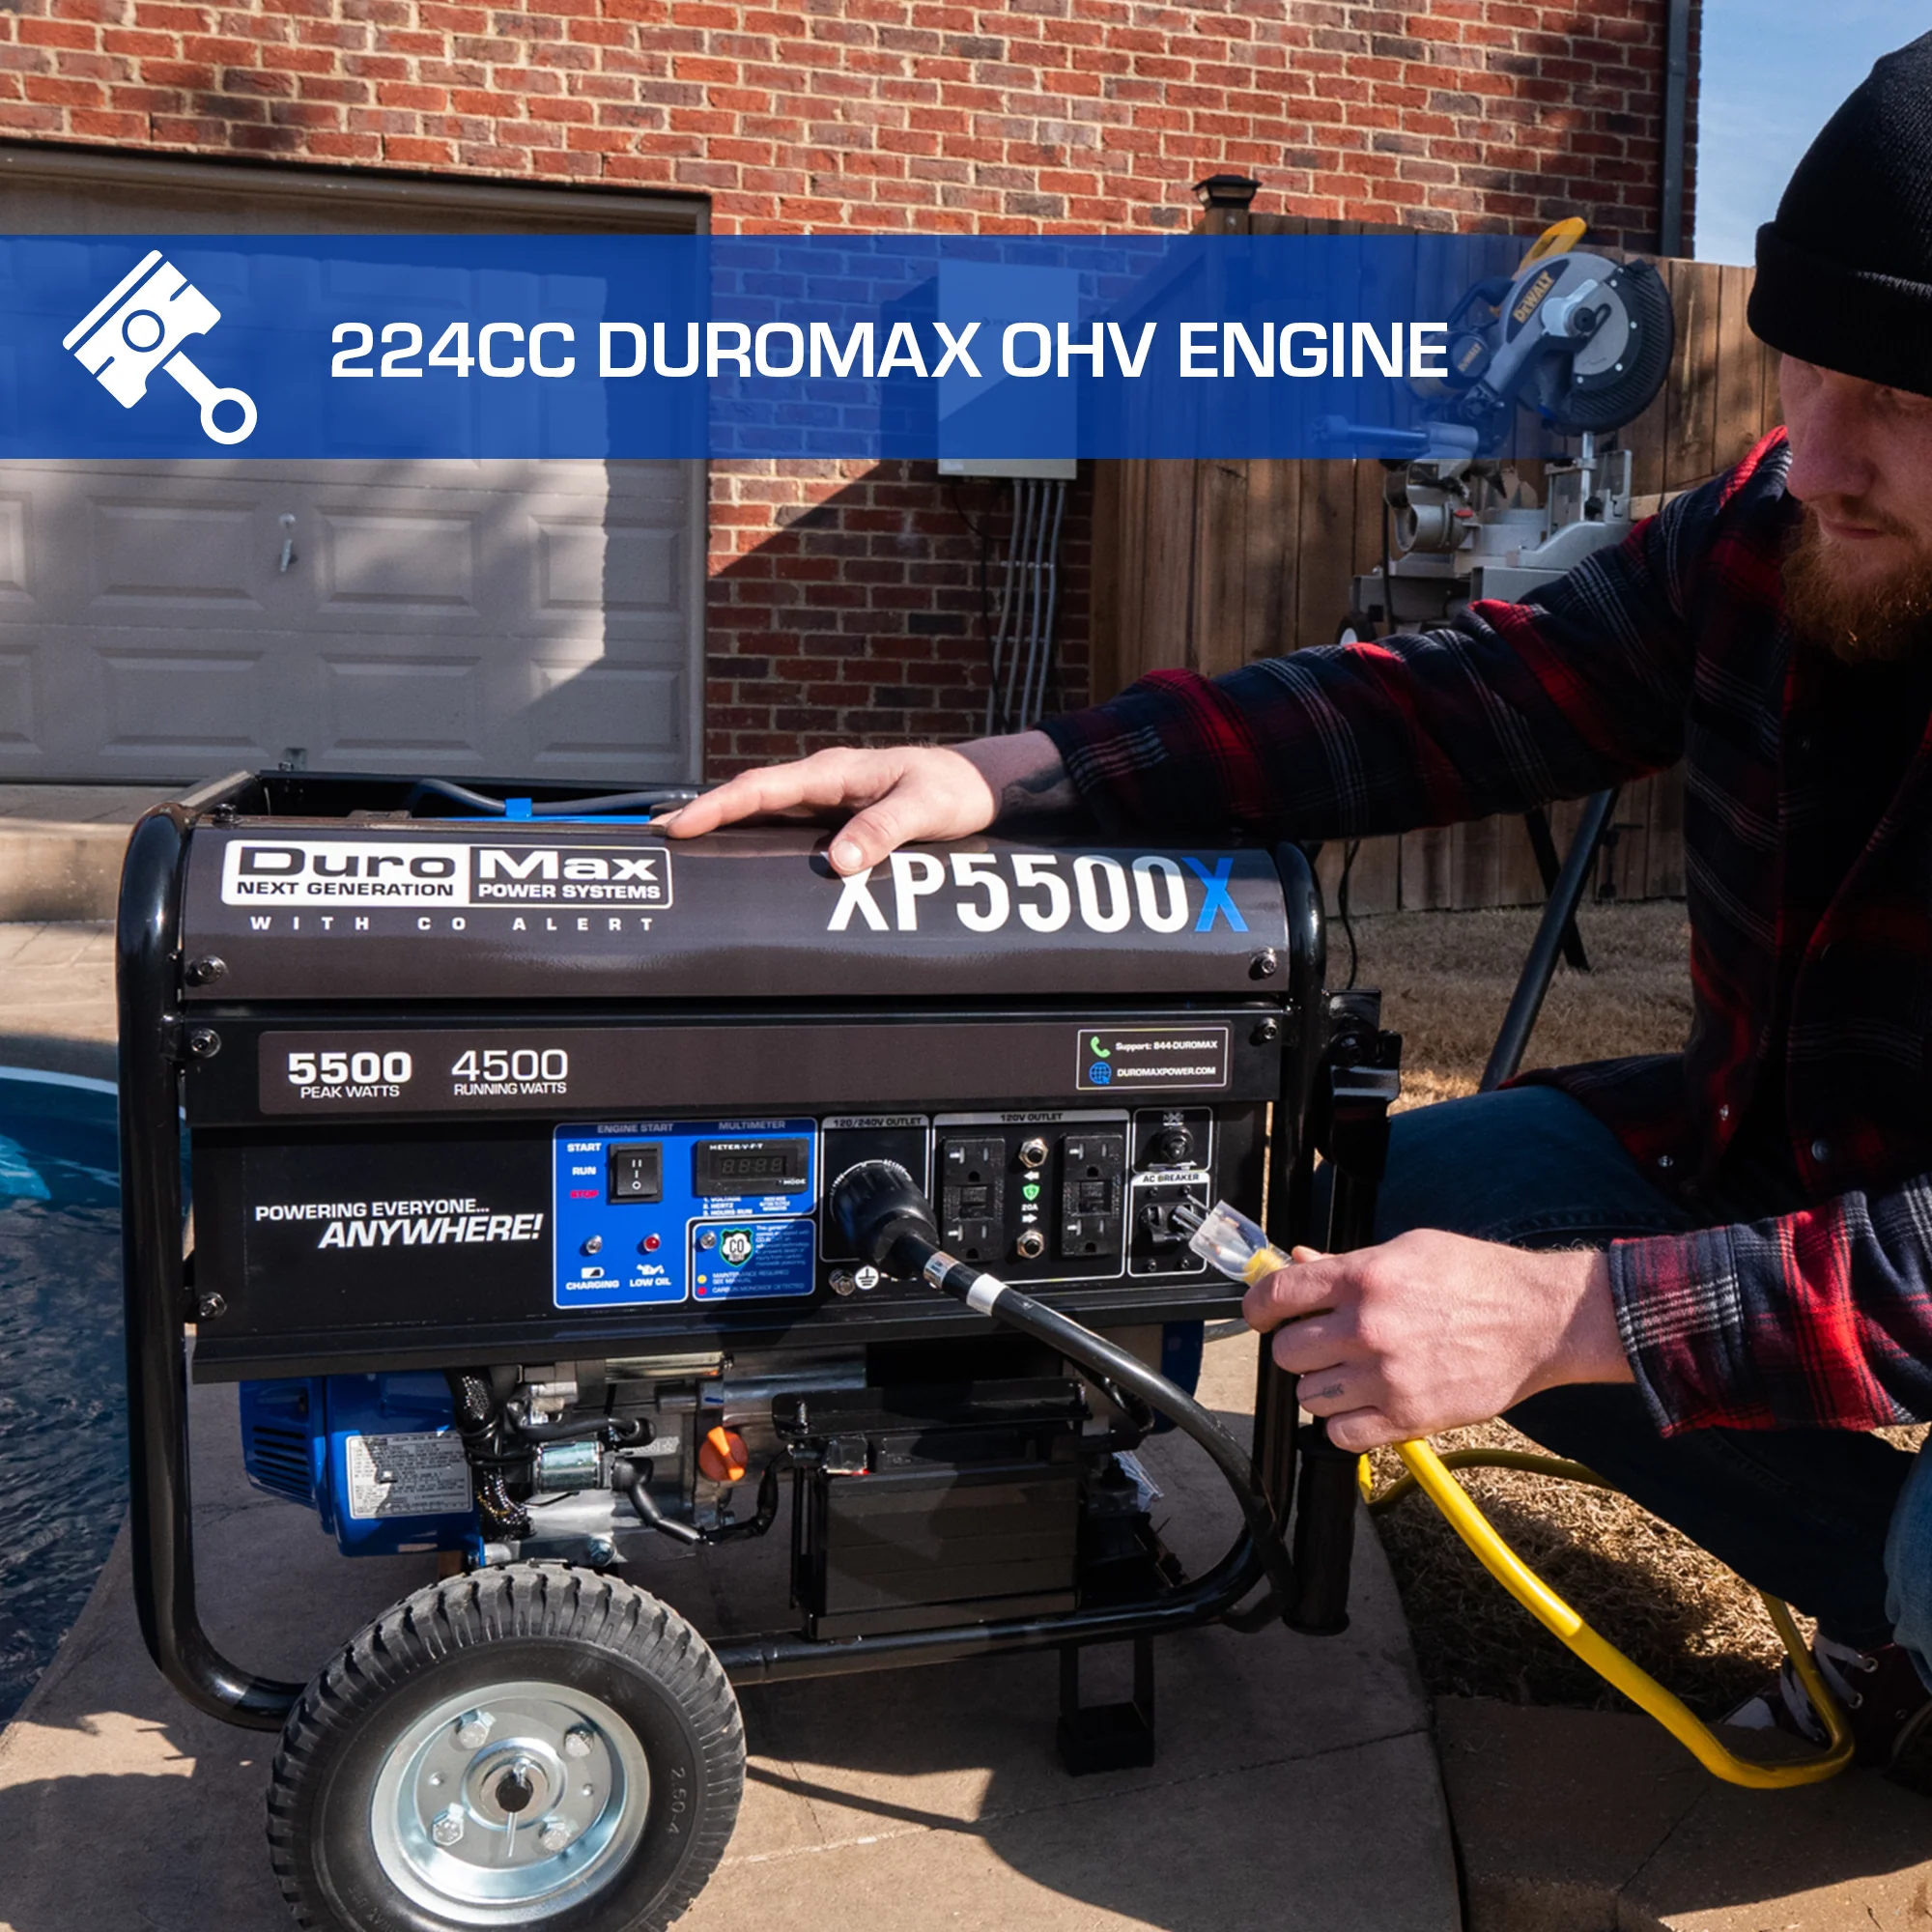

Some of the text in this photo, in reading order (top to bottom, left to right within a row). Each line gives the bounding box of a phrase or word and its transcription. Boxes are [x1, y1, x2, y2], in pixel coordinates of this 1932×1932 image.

[238, 846, 658, 880] Duro Max
[237, 881, 454, 896] NEXT GENERATION
[479, 884, 661, 899] POWER SYSTEMS
[250, 916, 653, 931] WITH CO ALERT
[1115, 1041, 1151, 1052] Support:
[288, 1051, 412, 1085] 5500
[451, 1049, 568, 1082] 4500
[1117, 1065, 1216, 1077] DUROMAXPOWER.COM
[300, 1085, 400, 1098] PEAK WATTS
[454, 1081, 567, 1095] RUNNING WATTS
[833, 1117, 923, 1128] 120/240V OUTLET
[1000, 1112, 1062, 1122] 120V OUTLET
[597, 1122, 674, 1134] ENGINE START
[718, 1121, 786, 1131] MULTIMETER
[567, 1143, 602, 1152] START
[572, 1167, 597, 1176] RUN
[1143, 1173, 1200, 1183] AC BREAKER
[255, 1198, 490, 1221] POWERING EVERYONE...
[1021, 1203, 1038, 1211] 20A
[317, 1213, 544, 1249] ANYWHERE!
[728, 1238, 745, 1254] CO
[565, 1280, 620, 1291] CHARGING
[629, 1277, 672, 1288] LOW OIL
